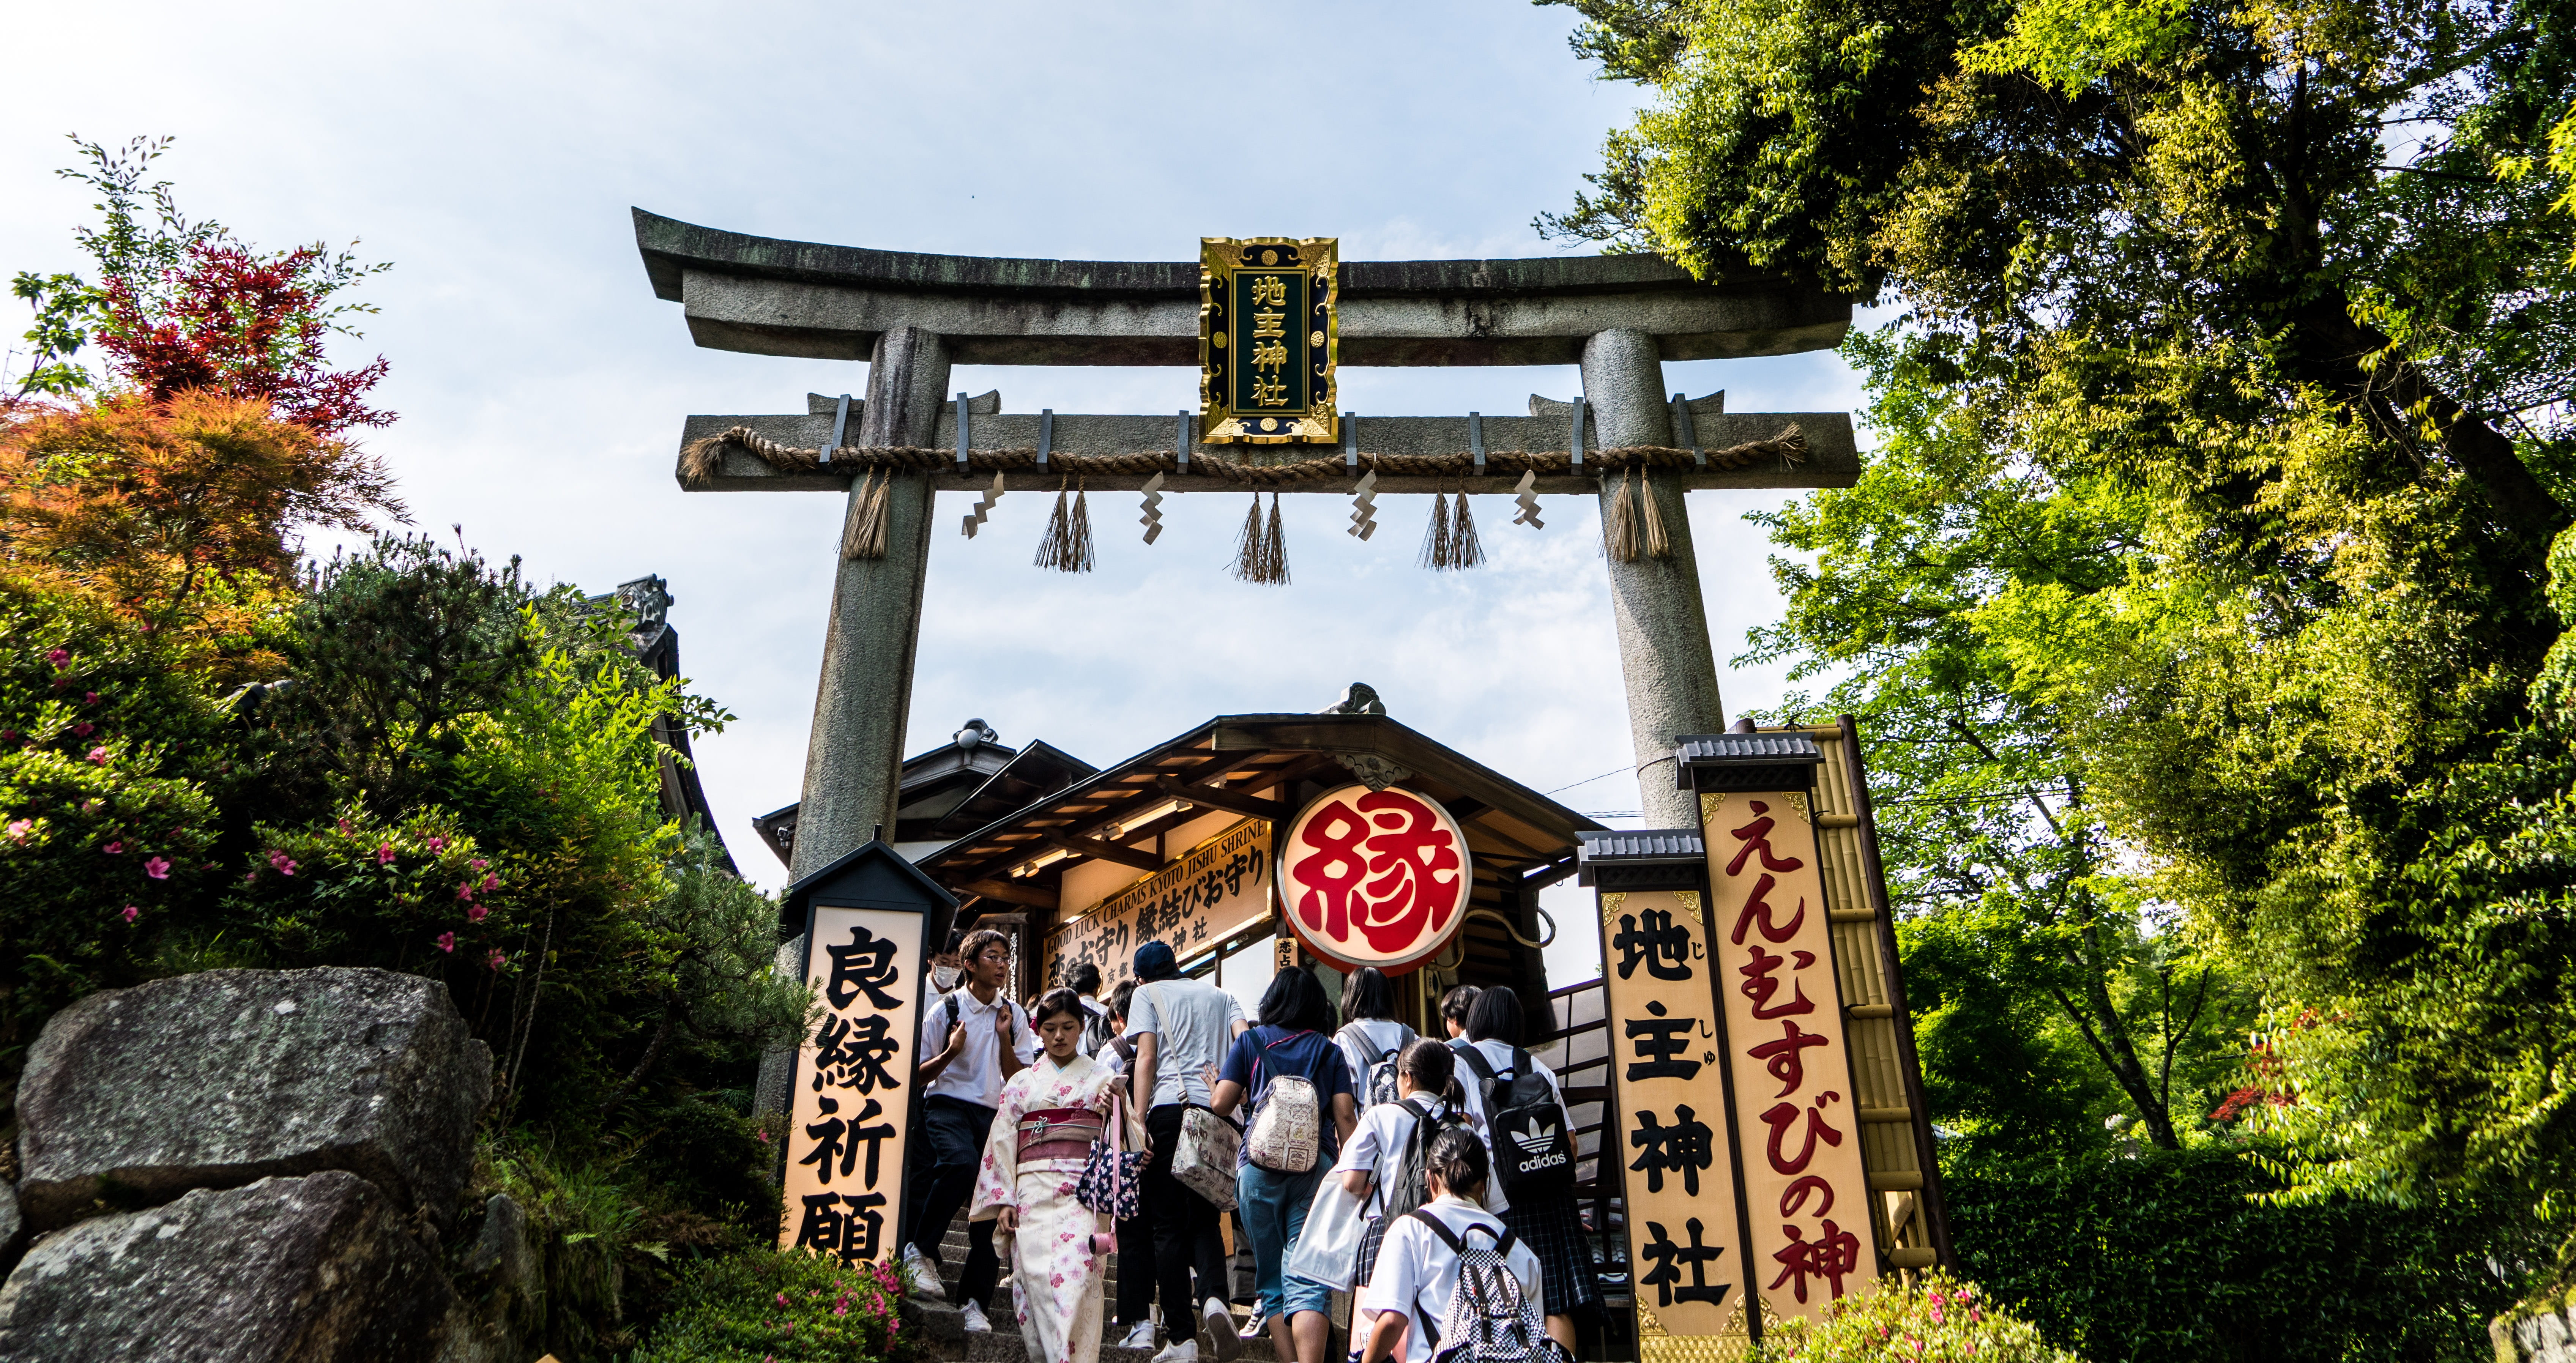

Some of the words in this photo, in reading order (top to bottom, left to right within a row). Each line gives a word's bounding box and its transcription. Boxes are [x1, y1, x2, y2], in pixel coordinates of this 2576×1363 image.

[1250, 276, 1288, 407] 地主神社
[1047, 928, 1072, 954] GOOD
[1075, 912, 1100, 940] LUCK
[1103, 886, 1146, 923] CHARMS
[1149, 865, 1183, 898] KYOTO
[1186, 845, 1218, 880] JISHU
[1221, 819, 1264, 858] SHRINE
[1135, 845, 1264, 947] 縁結びお守り
[1293, 790, 1460, 953] 縁
[1691, 941, 1705, 960] じ
[1698, 1019, 1716, 1066] しゅ
[1726, 799, 1861, 1319] えんむすびの神
[793, 926, 904, 1270] 良縁祈願
[1519, 1153, 1566, 1172] adidas
[1613, 908, 1732, 1308] 地主神社
